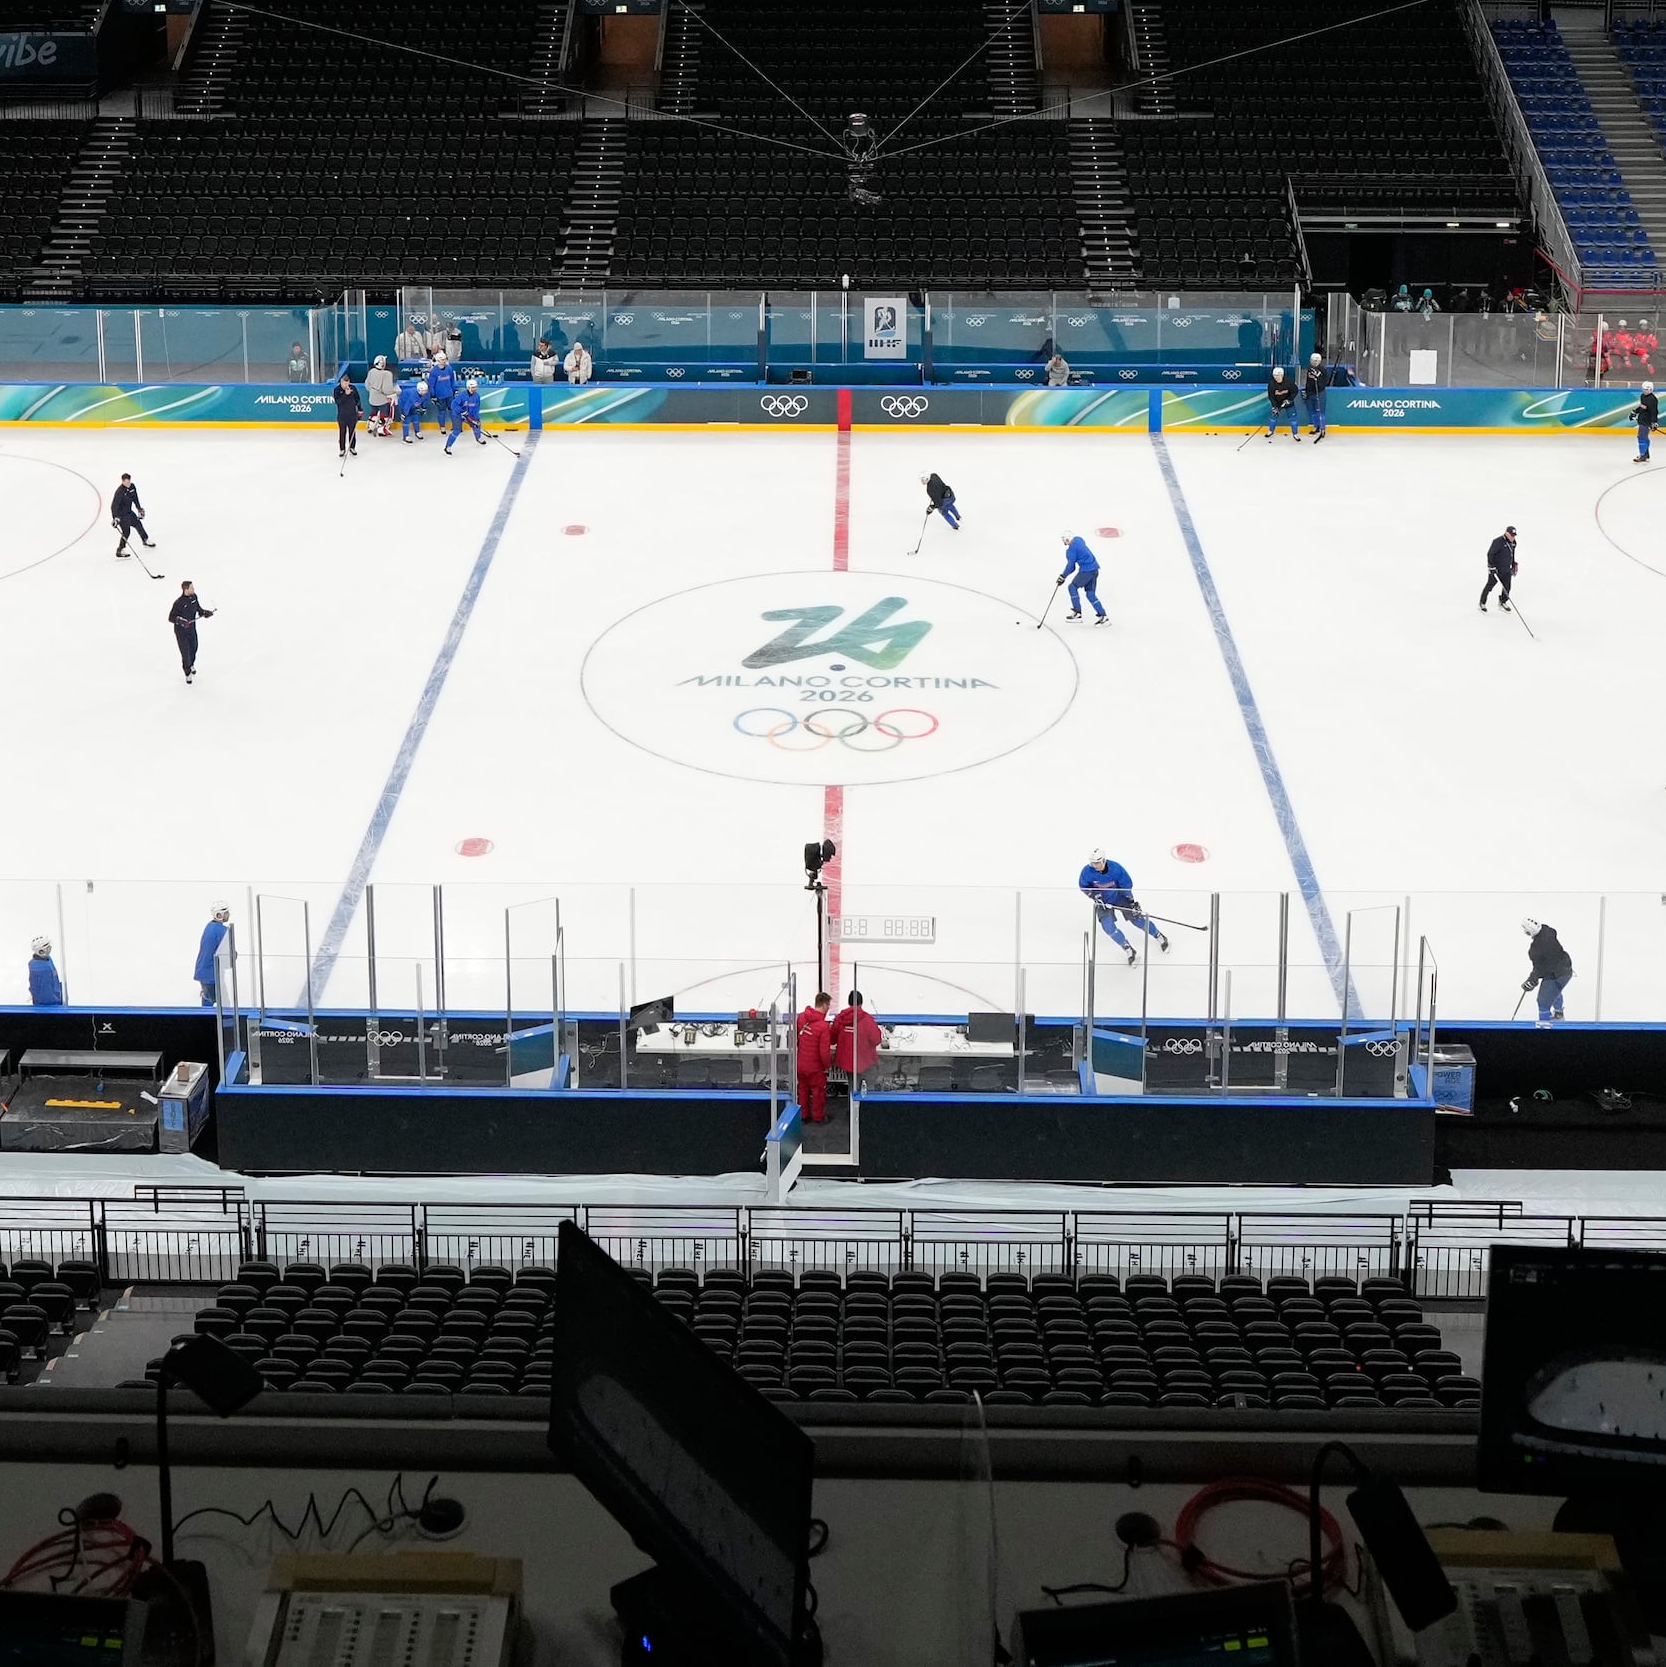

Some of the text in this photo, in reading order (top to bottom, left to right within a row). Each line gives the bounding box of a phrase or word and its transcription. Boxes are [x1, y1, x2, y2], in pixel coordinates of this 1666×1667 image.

[254, 395, 336, 404] MILANO CORTIN
[1346, 399, 1442, 409] MILANO CORTINA
[289, 404, 312, 413] 2026
[1382, 408, 1406, 418] 2026
[674, 675, 1001, 690] MILANO CORTINA
[799, 689, 874, 703] 2026
